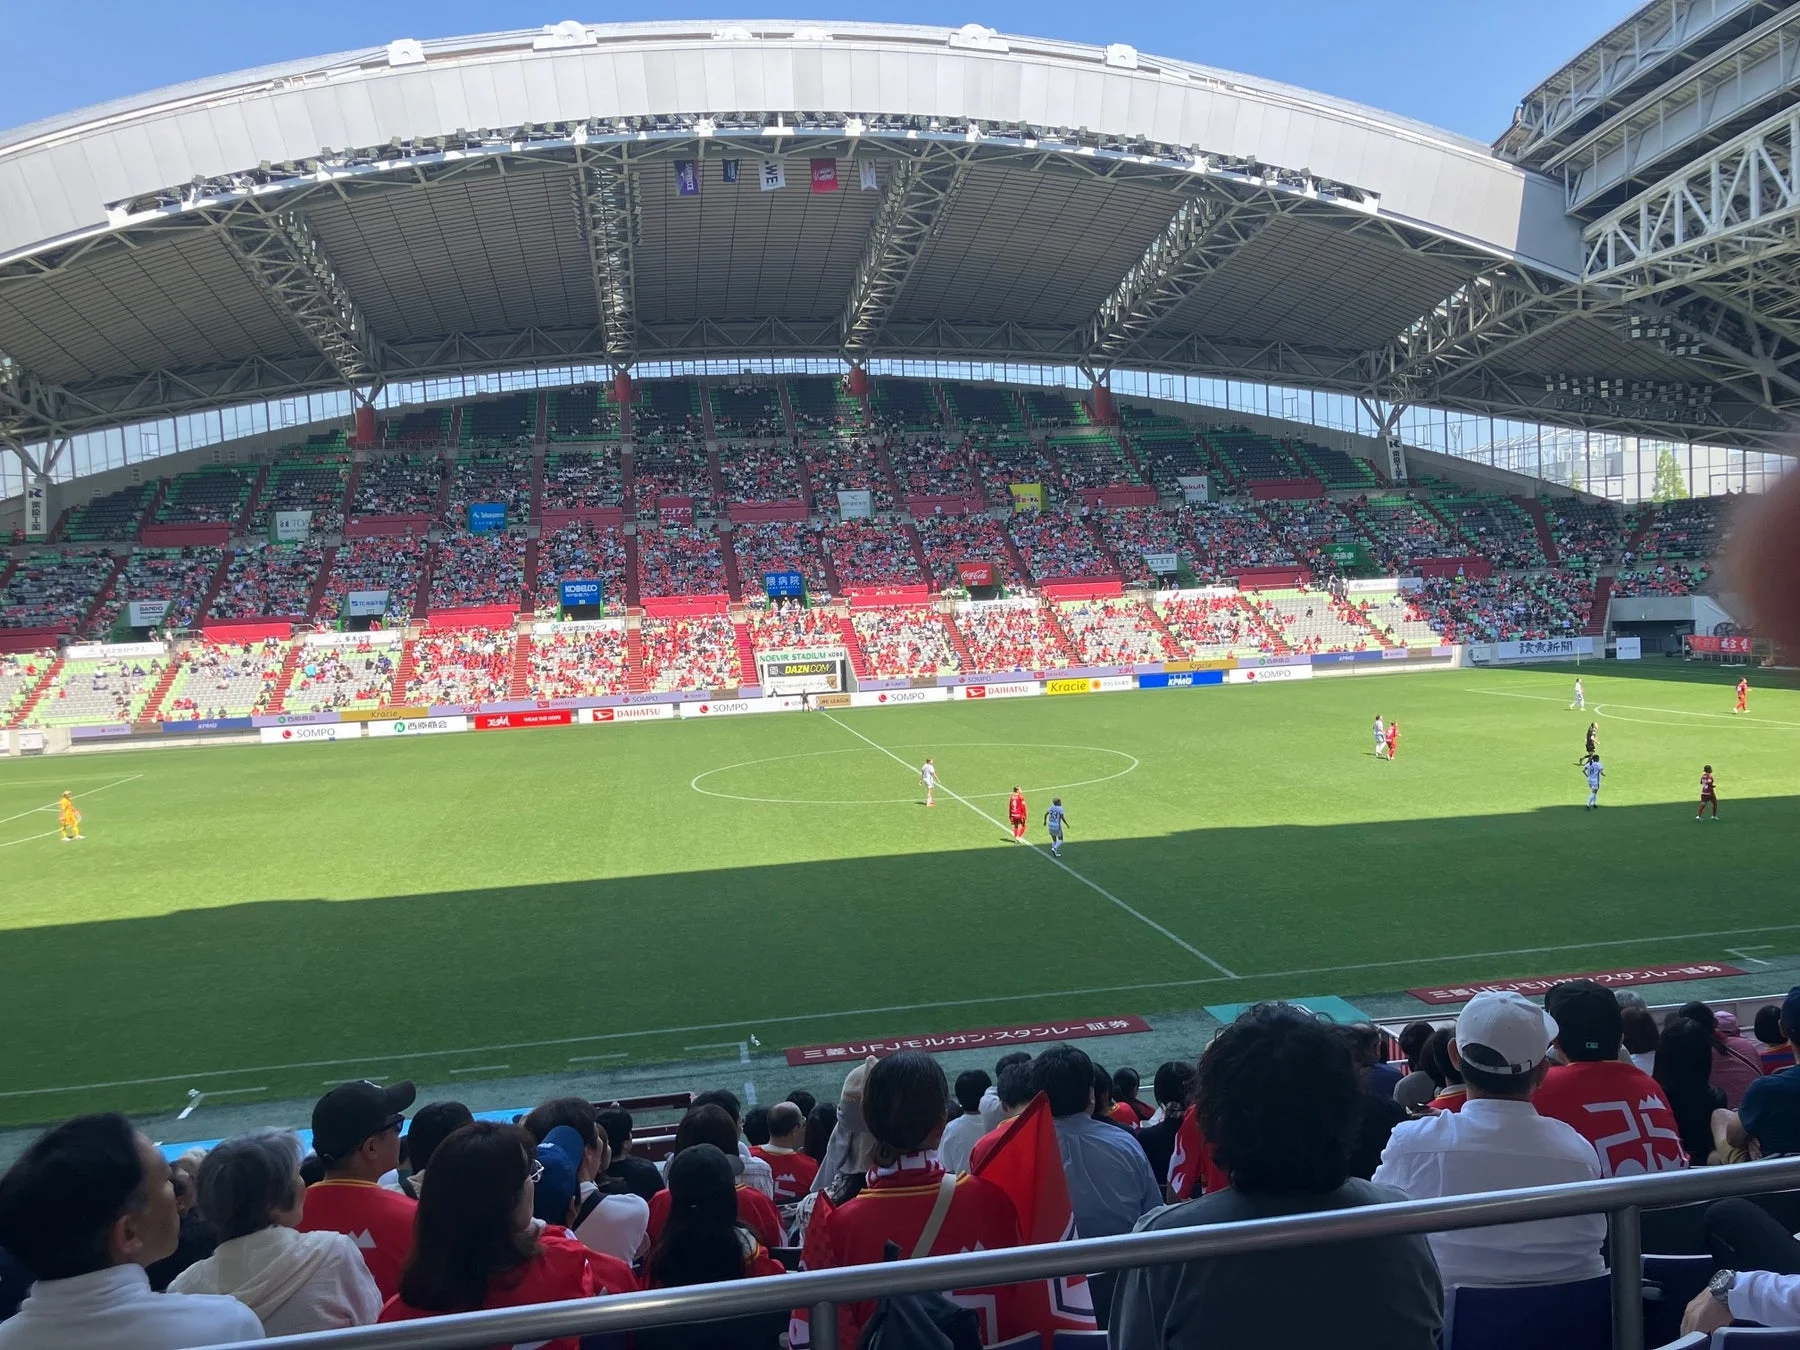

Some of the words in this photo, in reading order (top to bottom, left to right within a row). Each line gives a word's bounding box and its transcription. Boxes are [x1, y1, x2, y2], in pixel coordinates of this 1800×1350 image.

[960, 569, 988, 580] Coca-Cola
[565, 584, 598, 593] KOBELCO
[760, 654, 789, 662] NOEVIR
[791, 652, 826, 660] STADIUM
[1258, 669, 1291, 679] SOMPO
[1168, 674, 1192, 685] KPMG
[988, 685, 1029, 695] DAIHATSU
[1050, 682, 1087, 692] Kracie
[632, 695, 658, 703] SOMPO
[890, 692, 925, 701] SOMPO
[617, 708, 661, 718] DAIHATSU
[713, 703, 748, 713] SOMPO
[371, 711, 398, 719] Kracie
[296, 728, 336, 738] SOMPO
